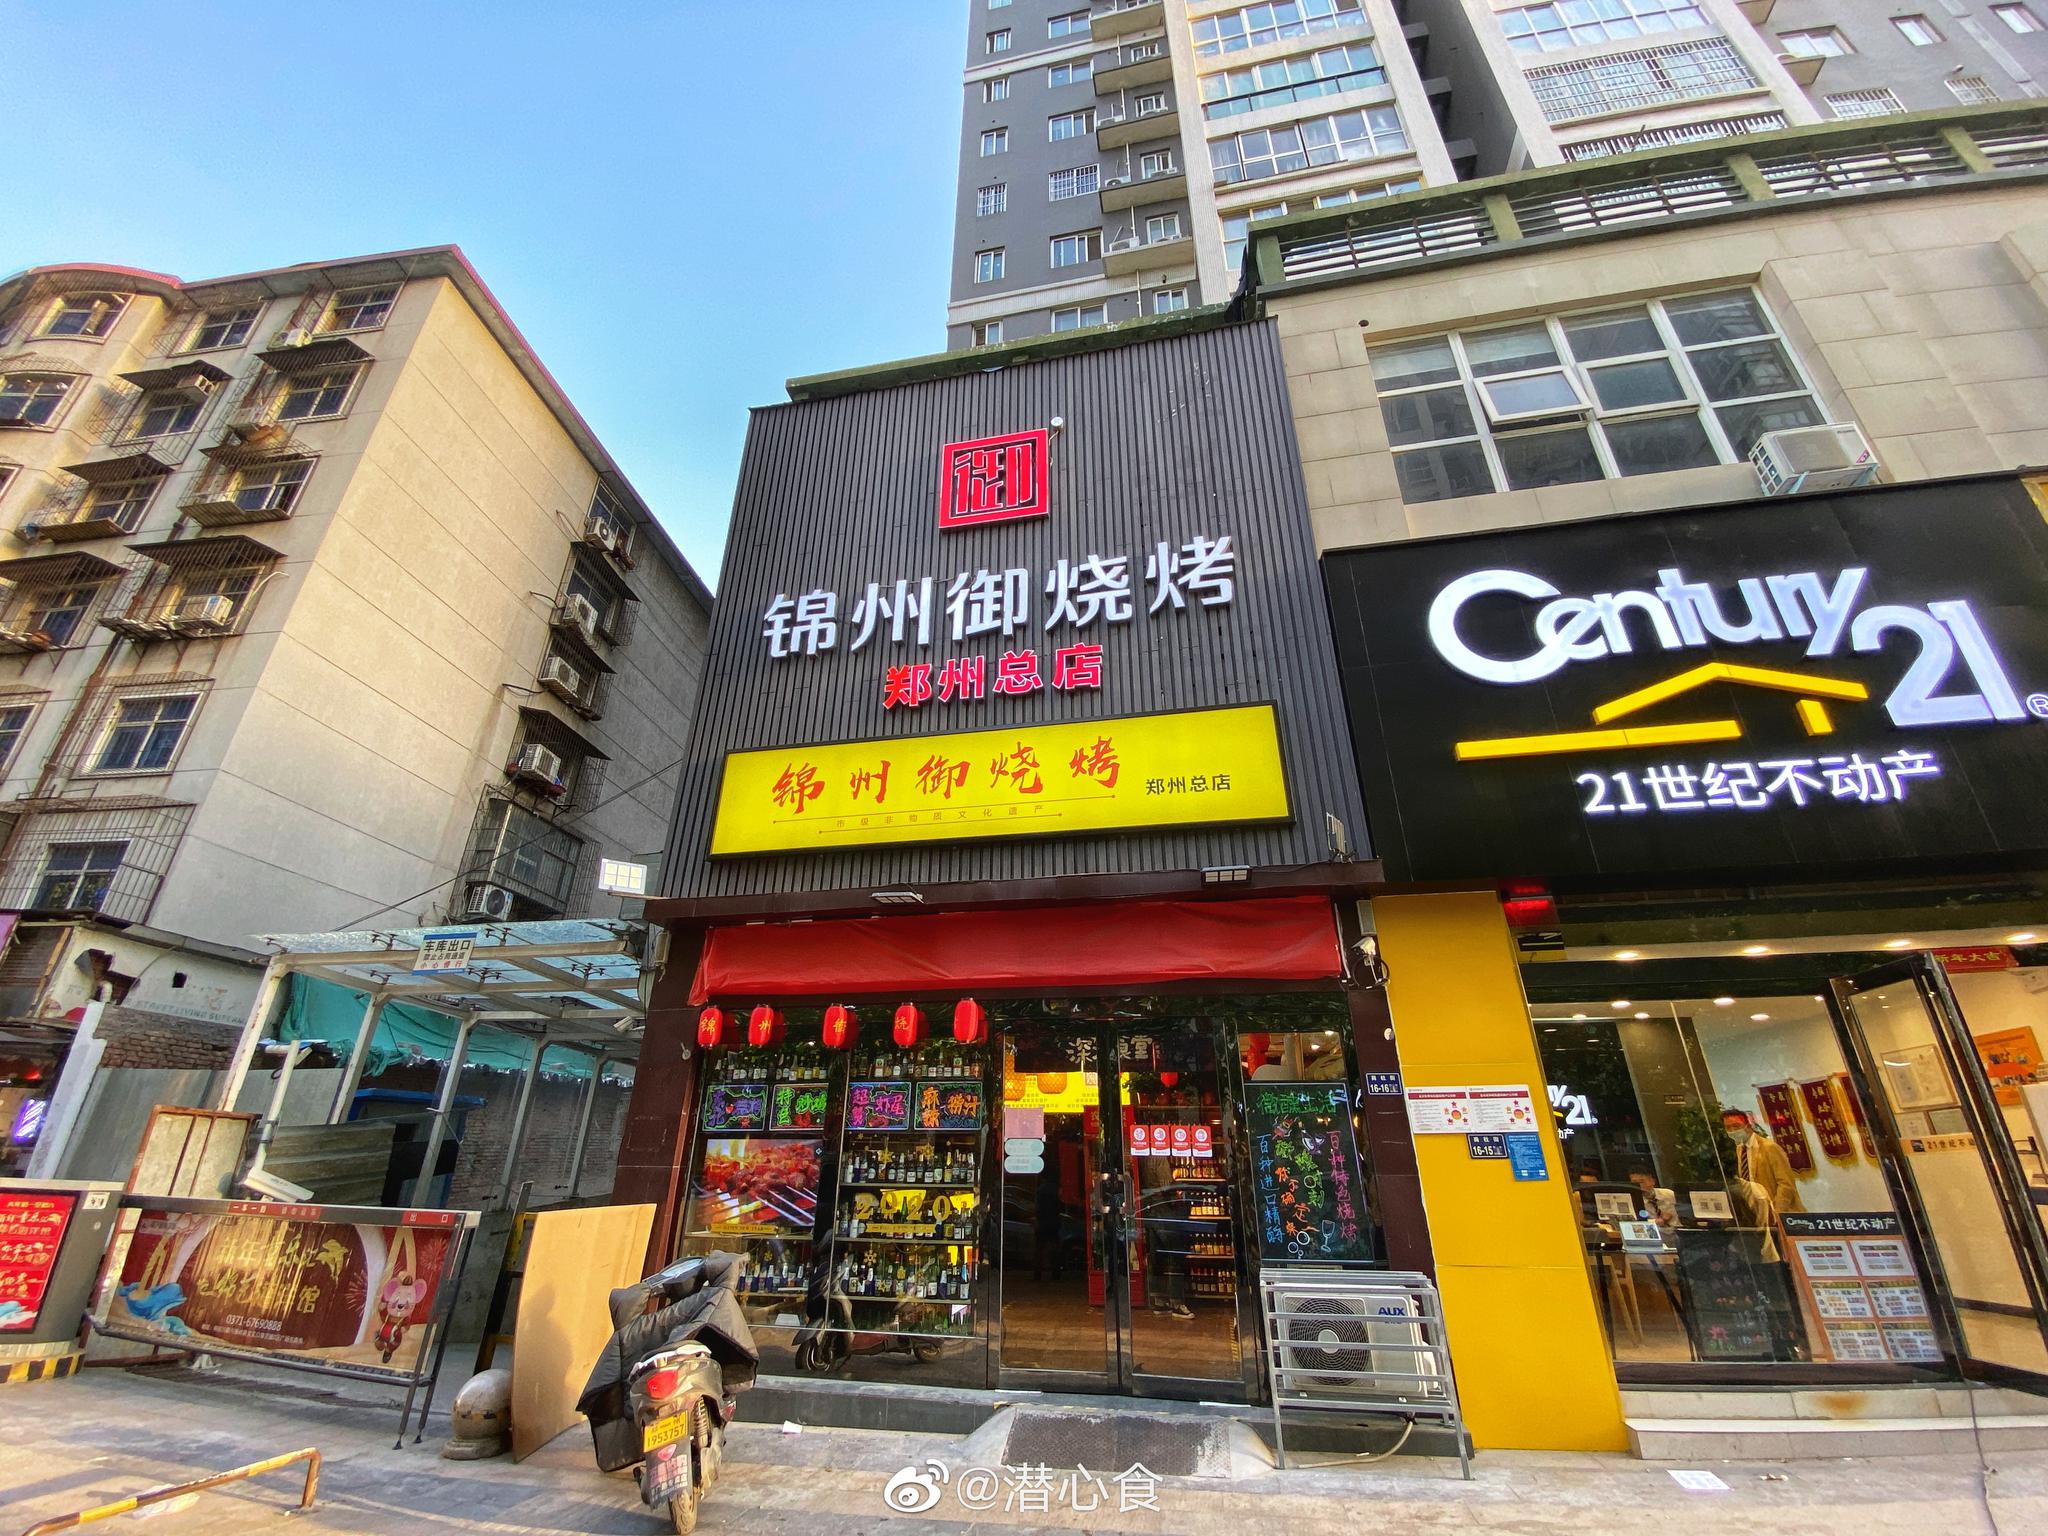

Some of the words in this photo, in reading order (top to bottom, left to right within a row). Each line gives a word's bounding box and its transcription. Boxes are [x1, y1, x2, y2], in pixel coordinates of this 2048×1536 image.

[763, 535, 1236, 659] 锦州御烧烤
[1427, 567, 1868, 686] Century
[1850, 599, 2027, 729] 21
[884, 643, 1104, 711] 郑州总店
[773, 736, 1122, 814] 锦州御烧烤
[1144, 773, 1232, 797] 郑州总店
[1573, 749, 1941, 815] 21世纪不动产
[836, 804, 1044, 829] 市级非物质文化遗产
[424, 940, 471, 952] 车库出口
[777, 1086, 795, 1126] 特色
[875, 1094, 905, 1116] 虾尾
[1257, 1134, 1286, 1243] 百种进口精酿
[1326, 1131, 1358, 1242] 百种特色烧烤
[1816, 1217, 1896, 1230] 21世纪不动产
[1378, 1306, 1405, 1316] AUX
